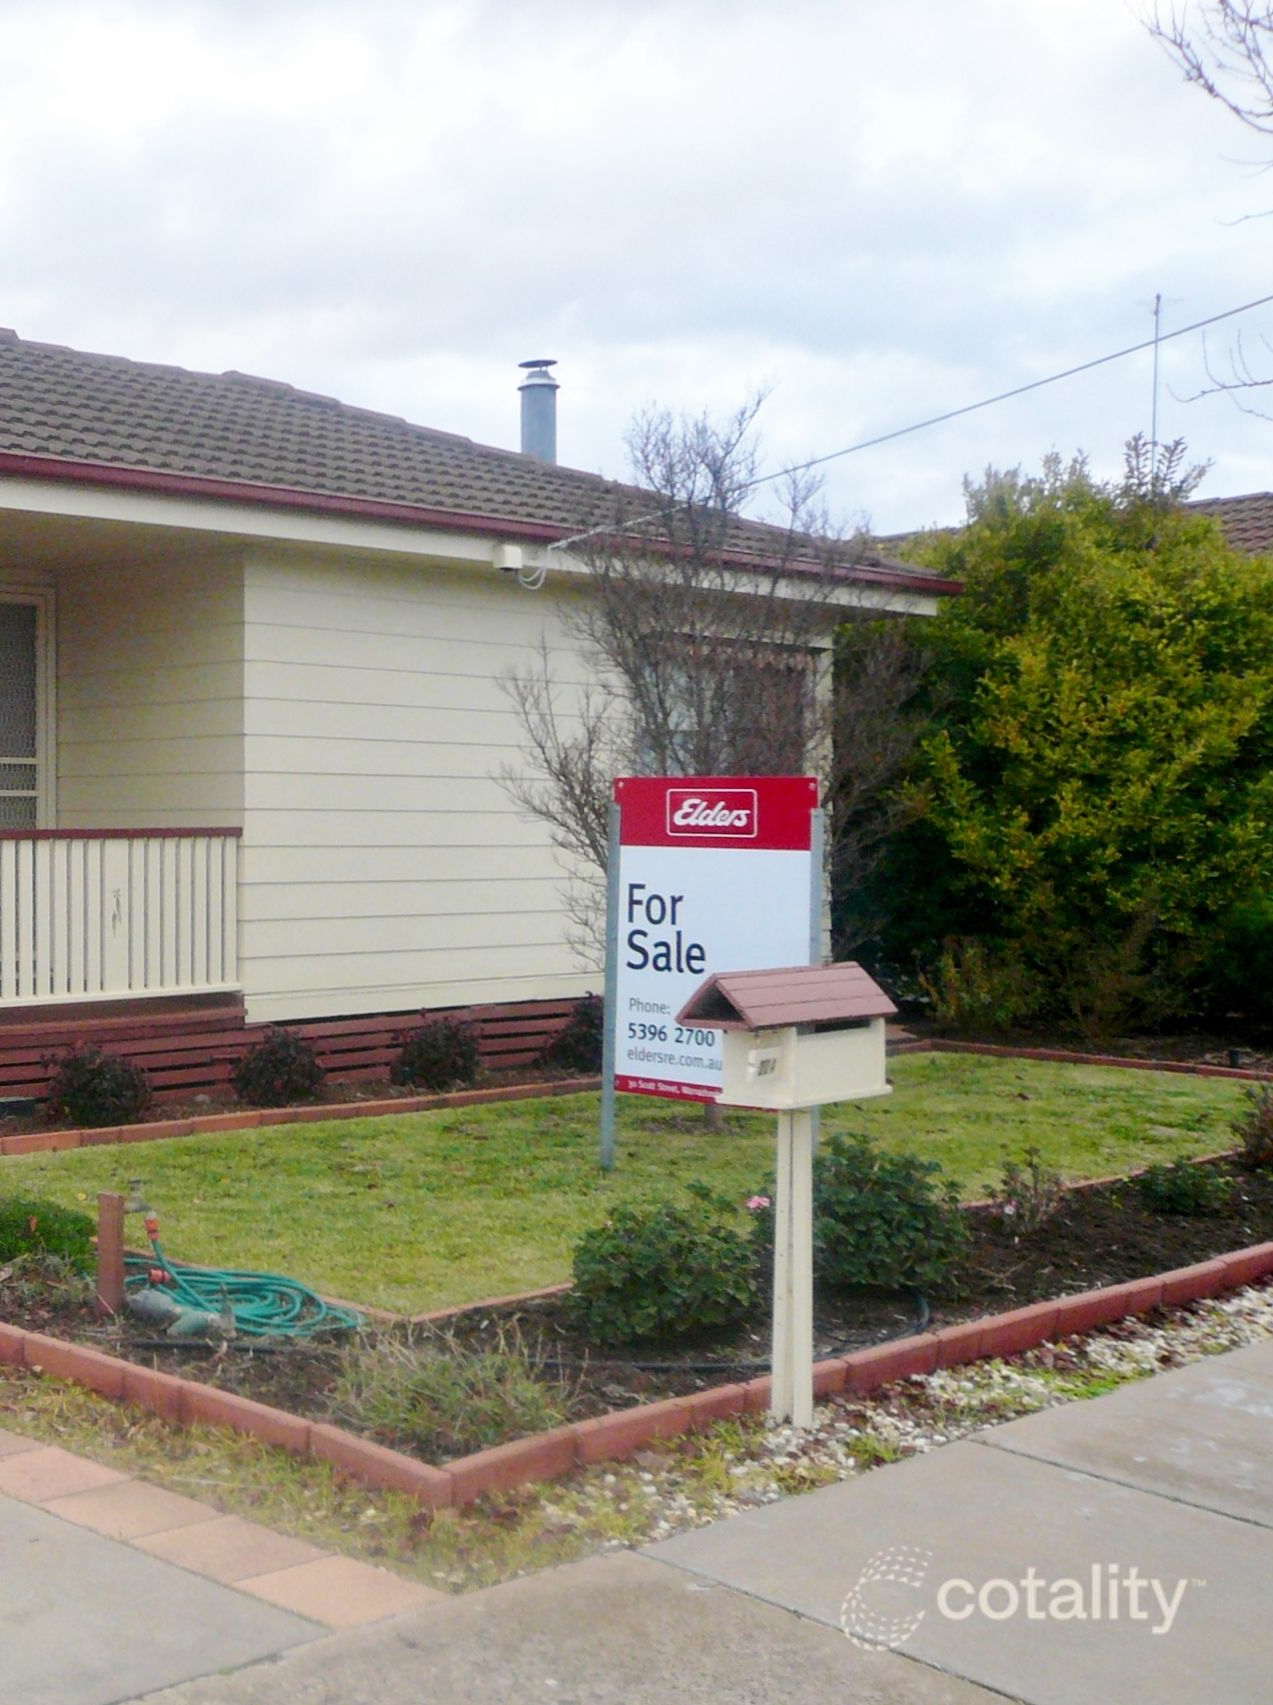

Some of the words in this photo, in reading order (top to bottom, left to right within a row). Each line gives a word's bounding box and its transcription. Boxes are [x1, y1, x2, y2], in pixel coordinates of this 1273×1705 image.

[673, 798, 751, 827] Elders
[628, 883, 684, 925] For
[626, 929, 706, 974] Sale
[629, 997, 671, 1015] Phone:
[628, 1023, 668, 1042] 5396
[674, 1027, 715, 1047] 2700
[627, 1046, 723, 1071] eldersre.com.au
